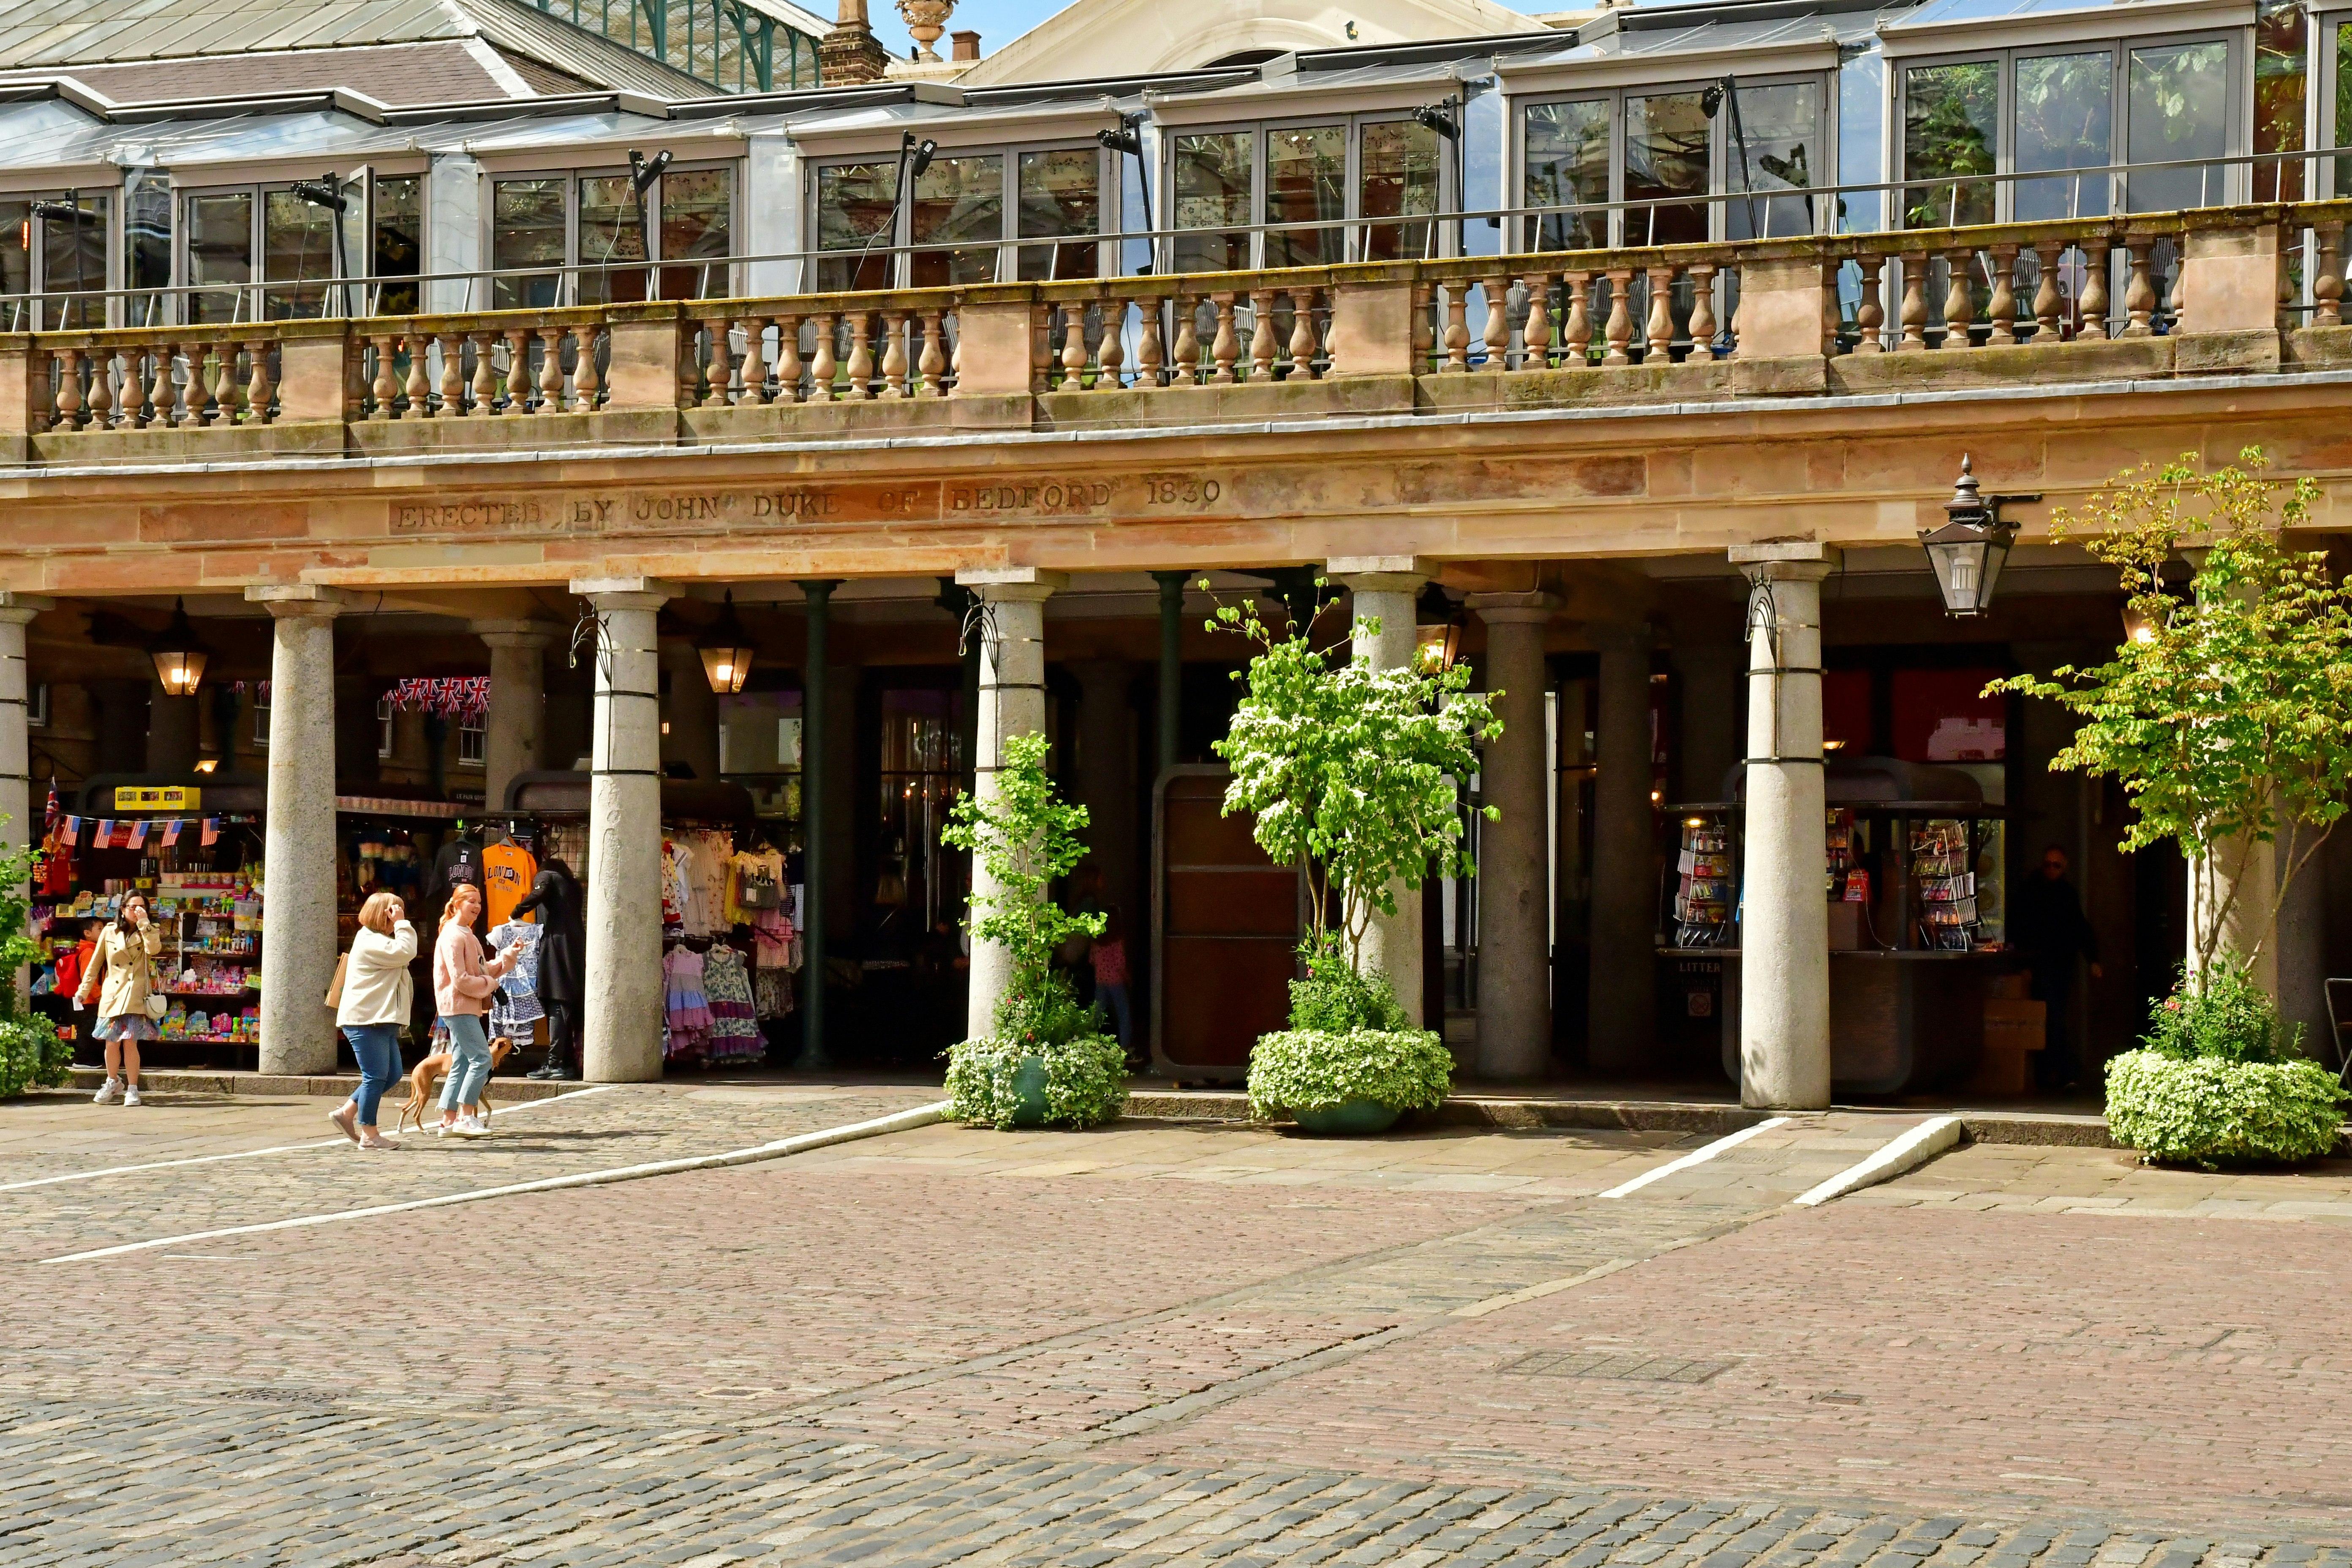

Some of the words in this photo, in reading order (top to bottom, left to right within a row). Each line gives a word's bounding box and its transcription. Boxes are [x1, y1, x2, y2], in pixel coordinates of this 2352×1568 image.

[398, 503, 542, 528] ERECTED
[574, 500, 615, 523] BY
[636, 497, 719, 520] JOHN
[753, 493, 840, 517] DUKE
[878, 490, 919, 512] OF
[952, 484, 1110, 510] BEDFORD
[1148, 480, 1220, 504] 1830
[1679, 962, 1720, 972] LITTER
